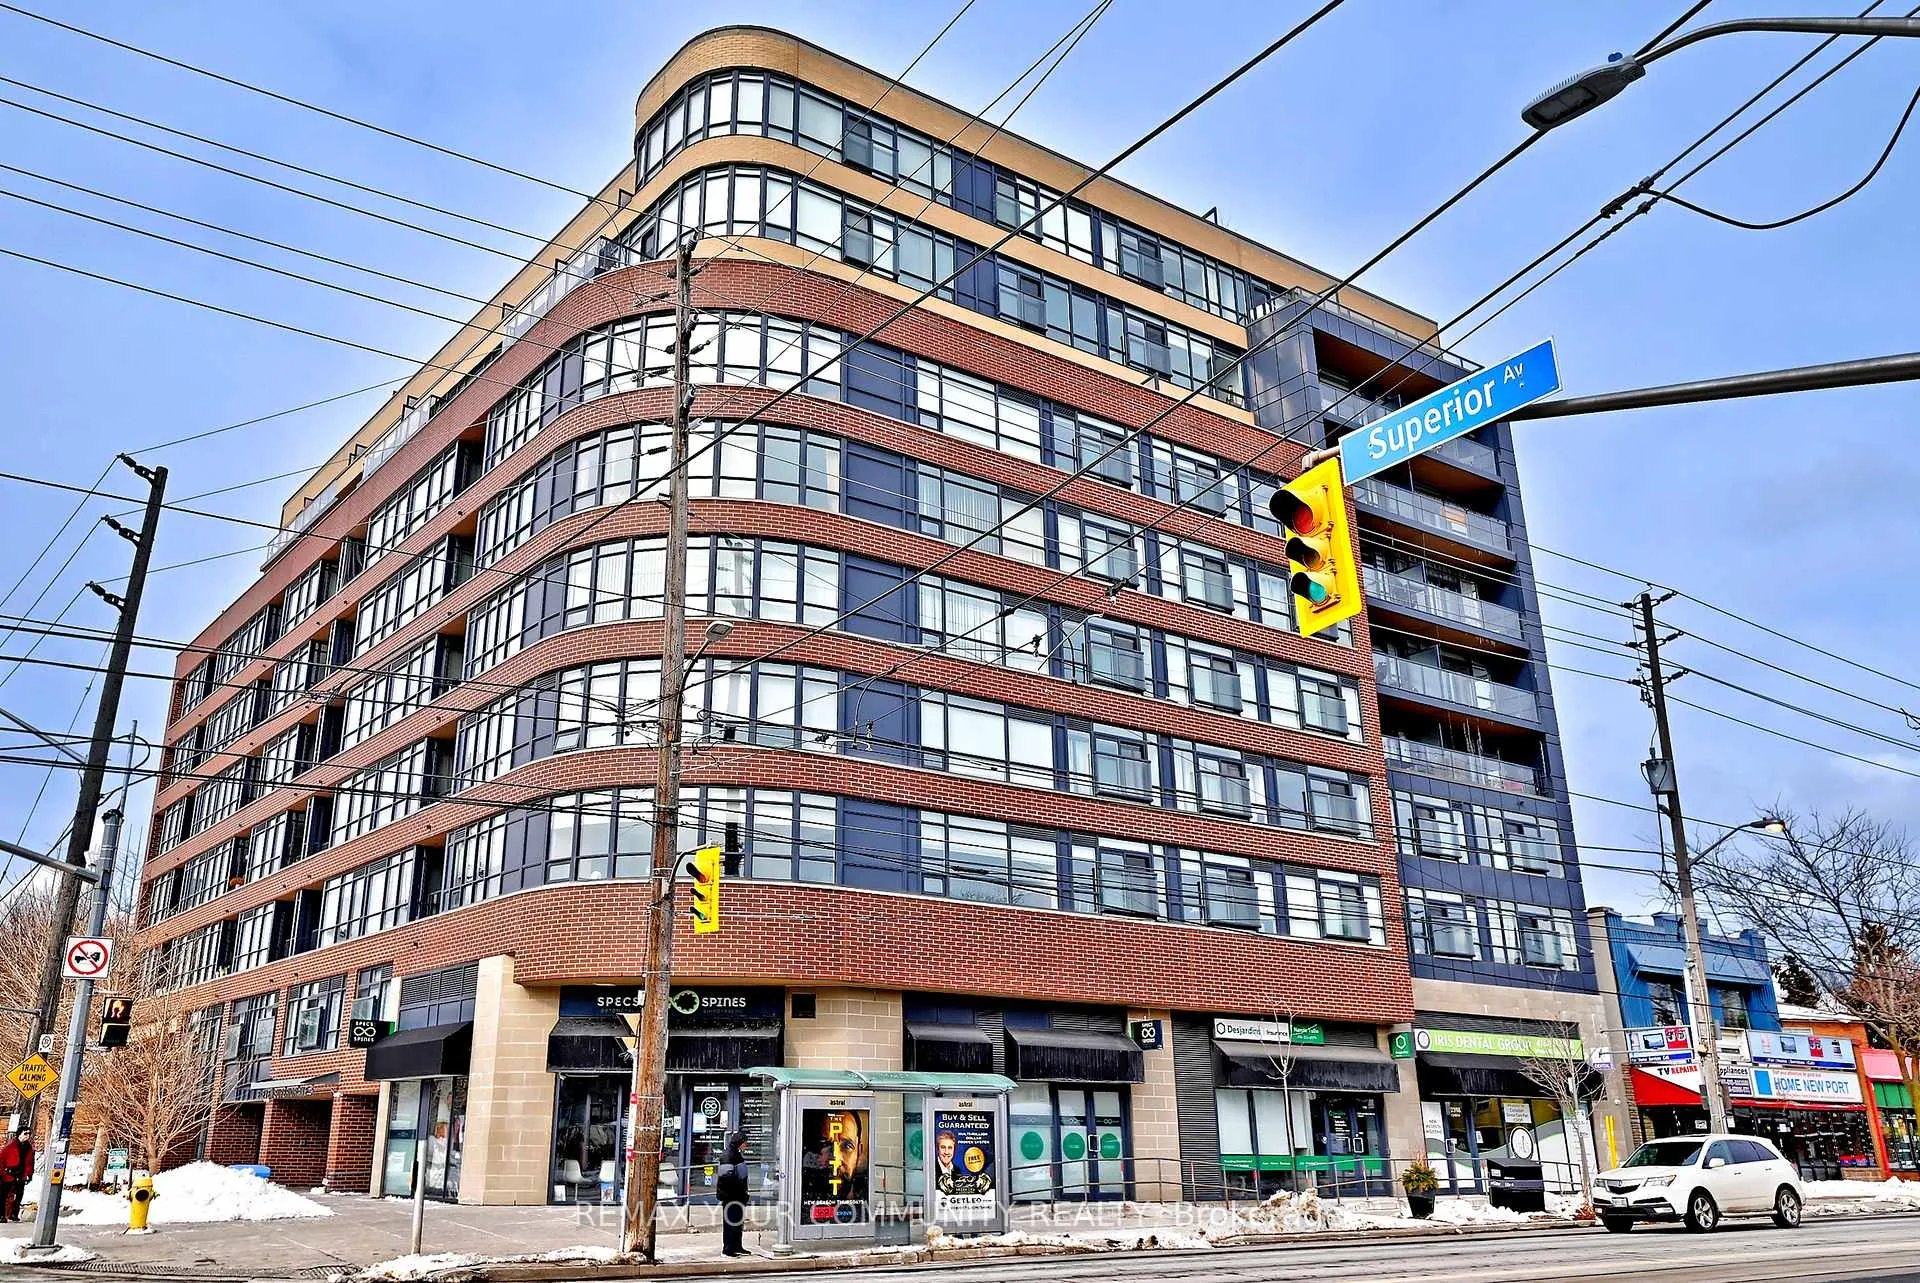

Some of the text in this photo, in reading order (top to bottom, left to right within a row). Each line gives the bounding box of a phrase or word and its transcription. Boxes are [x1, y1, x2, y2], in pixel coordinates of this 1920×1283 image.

[1367, 361, 1524, 460] Superior Av
[597, 997, 747, 1008] SPECS SPINES
[1434, 1034, 1454, 1047] IRIS
[1455, 1036, 1494, 1050] DENTAL
[21, 1064, 47, 1072] TRAFFIC
[1657, 1068, 1670, 1076] TV
[1719, 1066, 1748, 1077] ppliances
[1773, 1077, 1849, 1094] HOME NEW PORT
[938, 1121, 990, 1129] GUARANTEED
